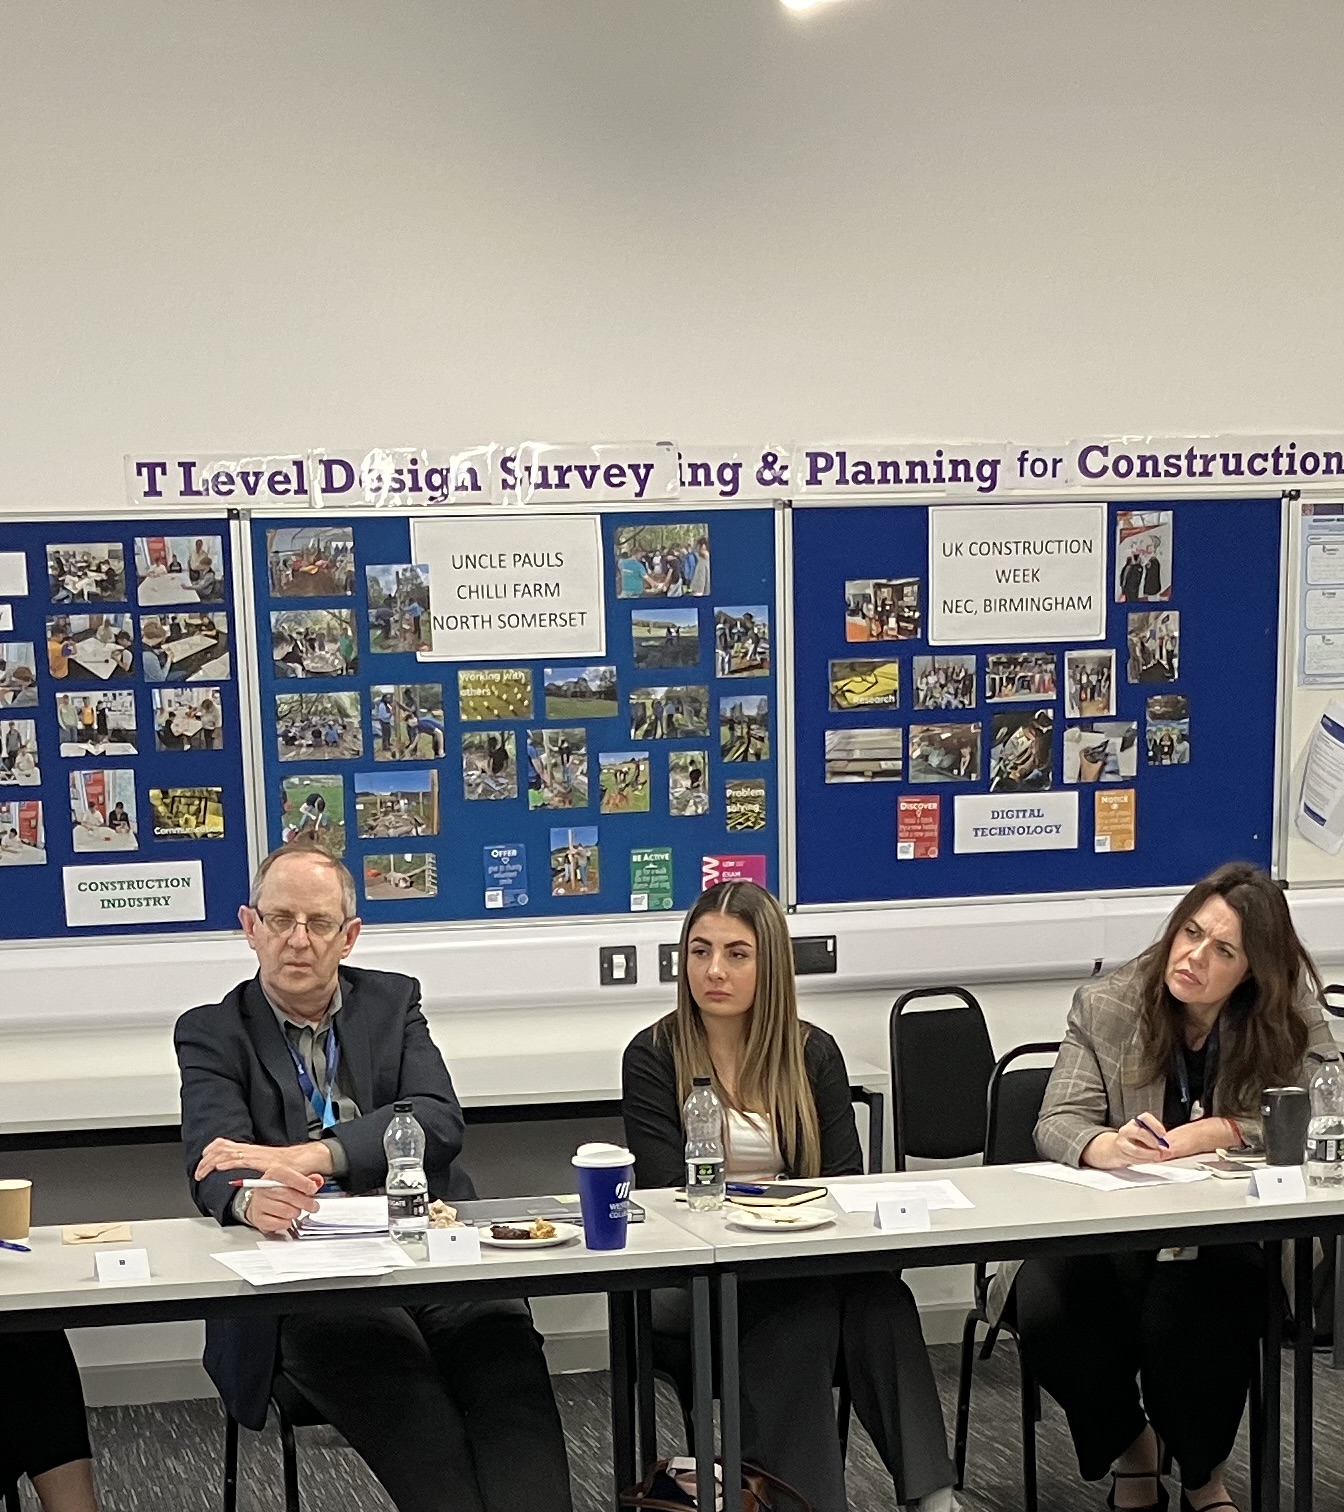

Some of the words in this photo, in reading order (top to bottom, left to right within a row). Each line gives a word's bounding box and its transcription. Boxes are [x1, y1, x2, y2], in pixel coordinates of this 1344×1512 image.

[136, 461, 167, 498] T
[178, 461, 309, 497] Level
[319, 457, 482, 505] Design
[756, 452, 789, 486] &
[805, 451, 1001, 493] Planning
[1017, 450, 1063, 479] for
[942, 542, 964, 557] UK
[968, 539, 1093, 556] CONSTRUCTION
[452, 553, 506, 569] UNCLE
[513, 552, 564, 568] PAULS
[996, 568, 1040, 583] WEEK
[457, 584, 507, 600] CHILLI
[513, 583, 561, 598] FARM
[942, 599, 977, 615] NEC,
[984, 596, 1092, 613] BIRMINGHAM
[433, 615, 492, 631] NORTH
[497, 612, 587, 629] SOMERSET
[991, 808, 1044, 819] DIGITAL
[972, 825, 1062, 837] TECHNOLOGY
[77, 877, 192, 892] CONSTRUCTION
[100, 896, 172, 909] INDUSTRY
